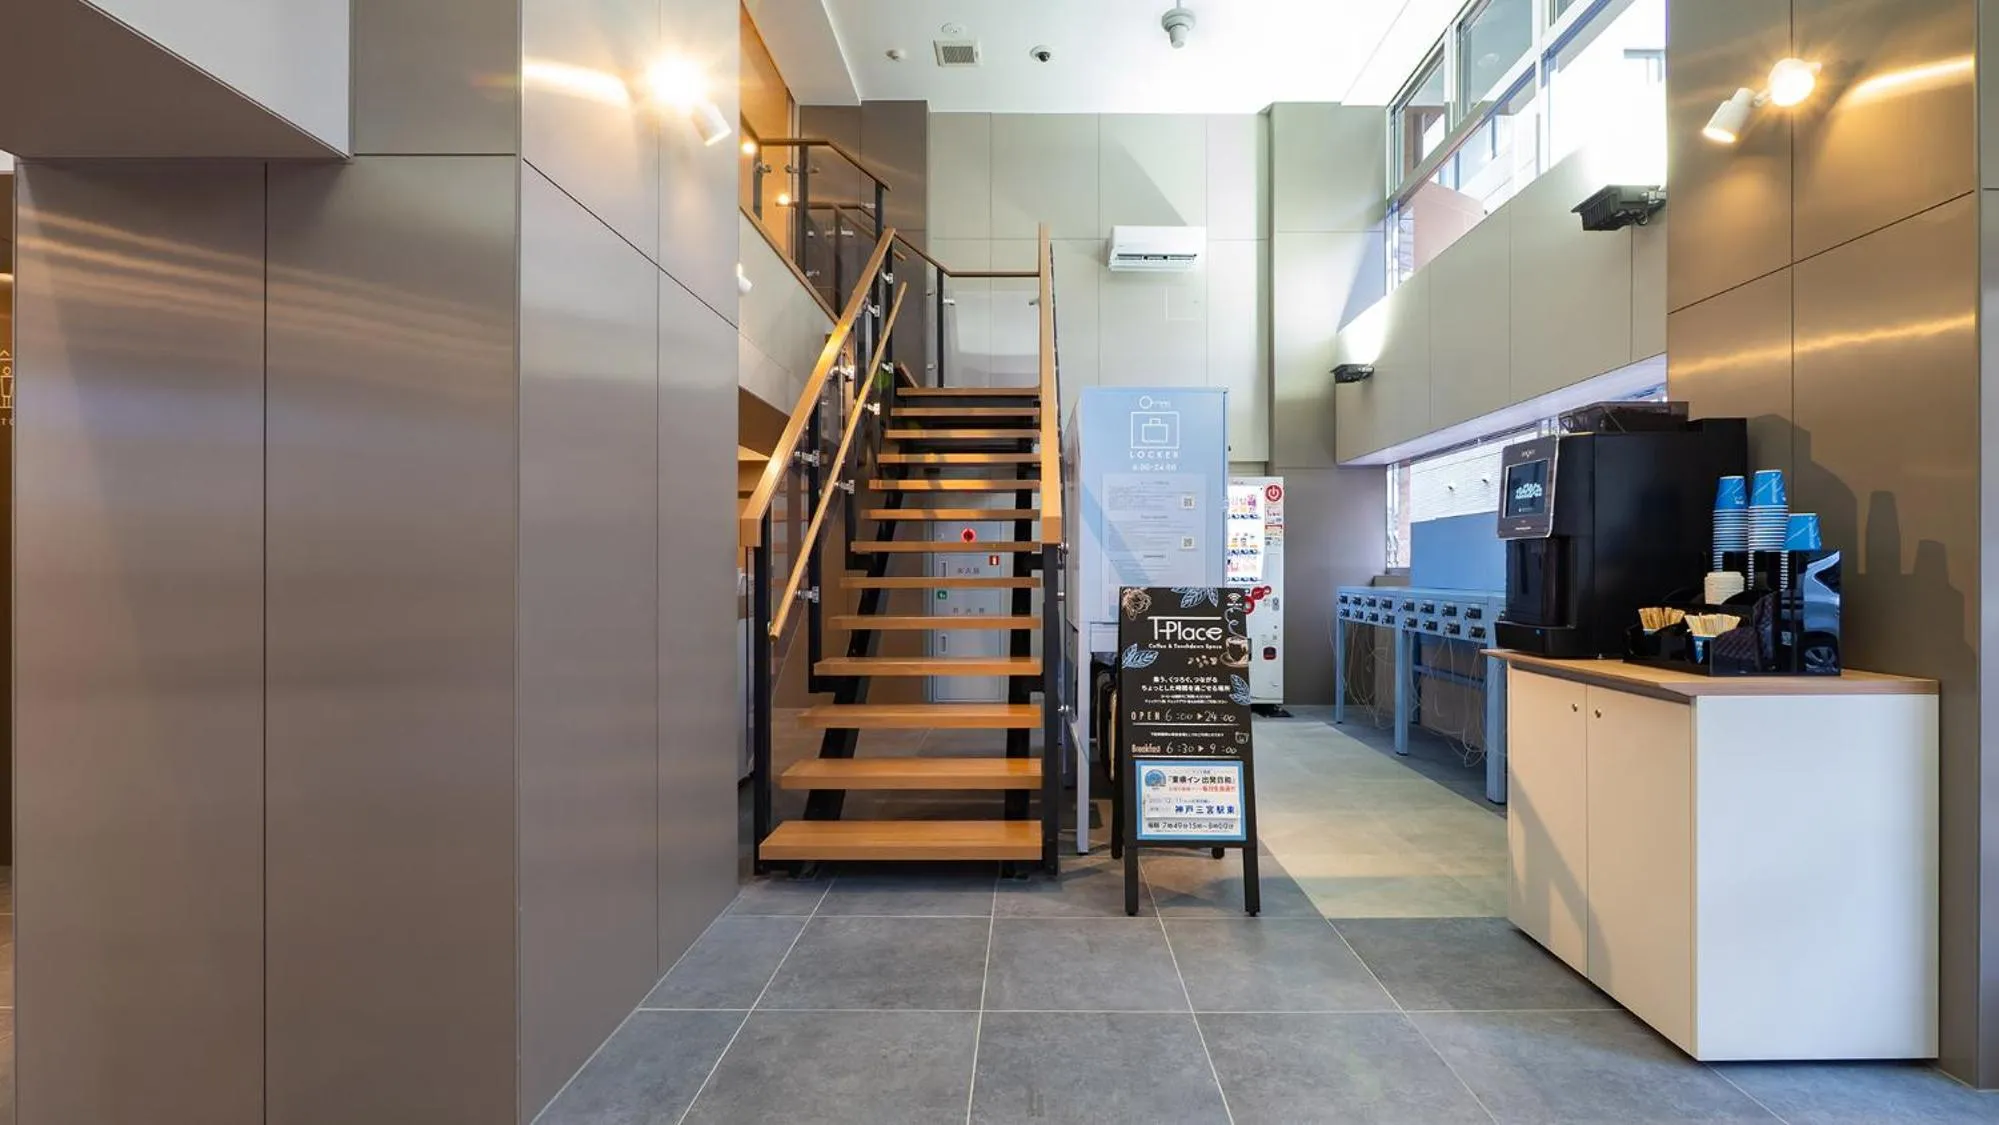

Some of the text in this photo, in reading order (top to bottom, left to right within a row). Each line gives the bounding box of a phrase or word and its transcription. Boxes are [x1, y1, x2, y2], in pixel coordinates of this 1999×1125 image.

[1129, 450, 1179, 459] LOCKER
[1147, 616, 1223, 641] T-Place
[1131, 711, 1160, 721] OPEN
[1175, 805, 1235, 814] 神戸三宮駅東
